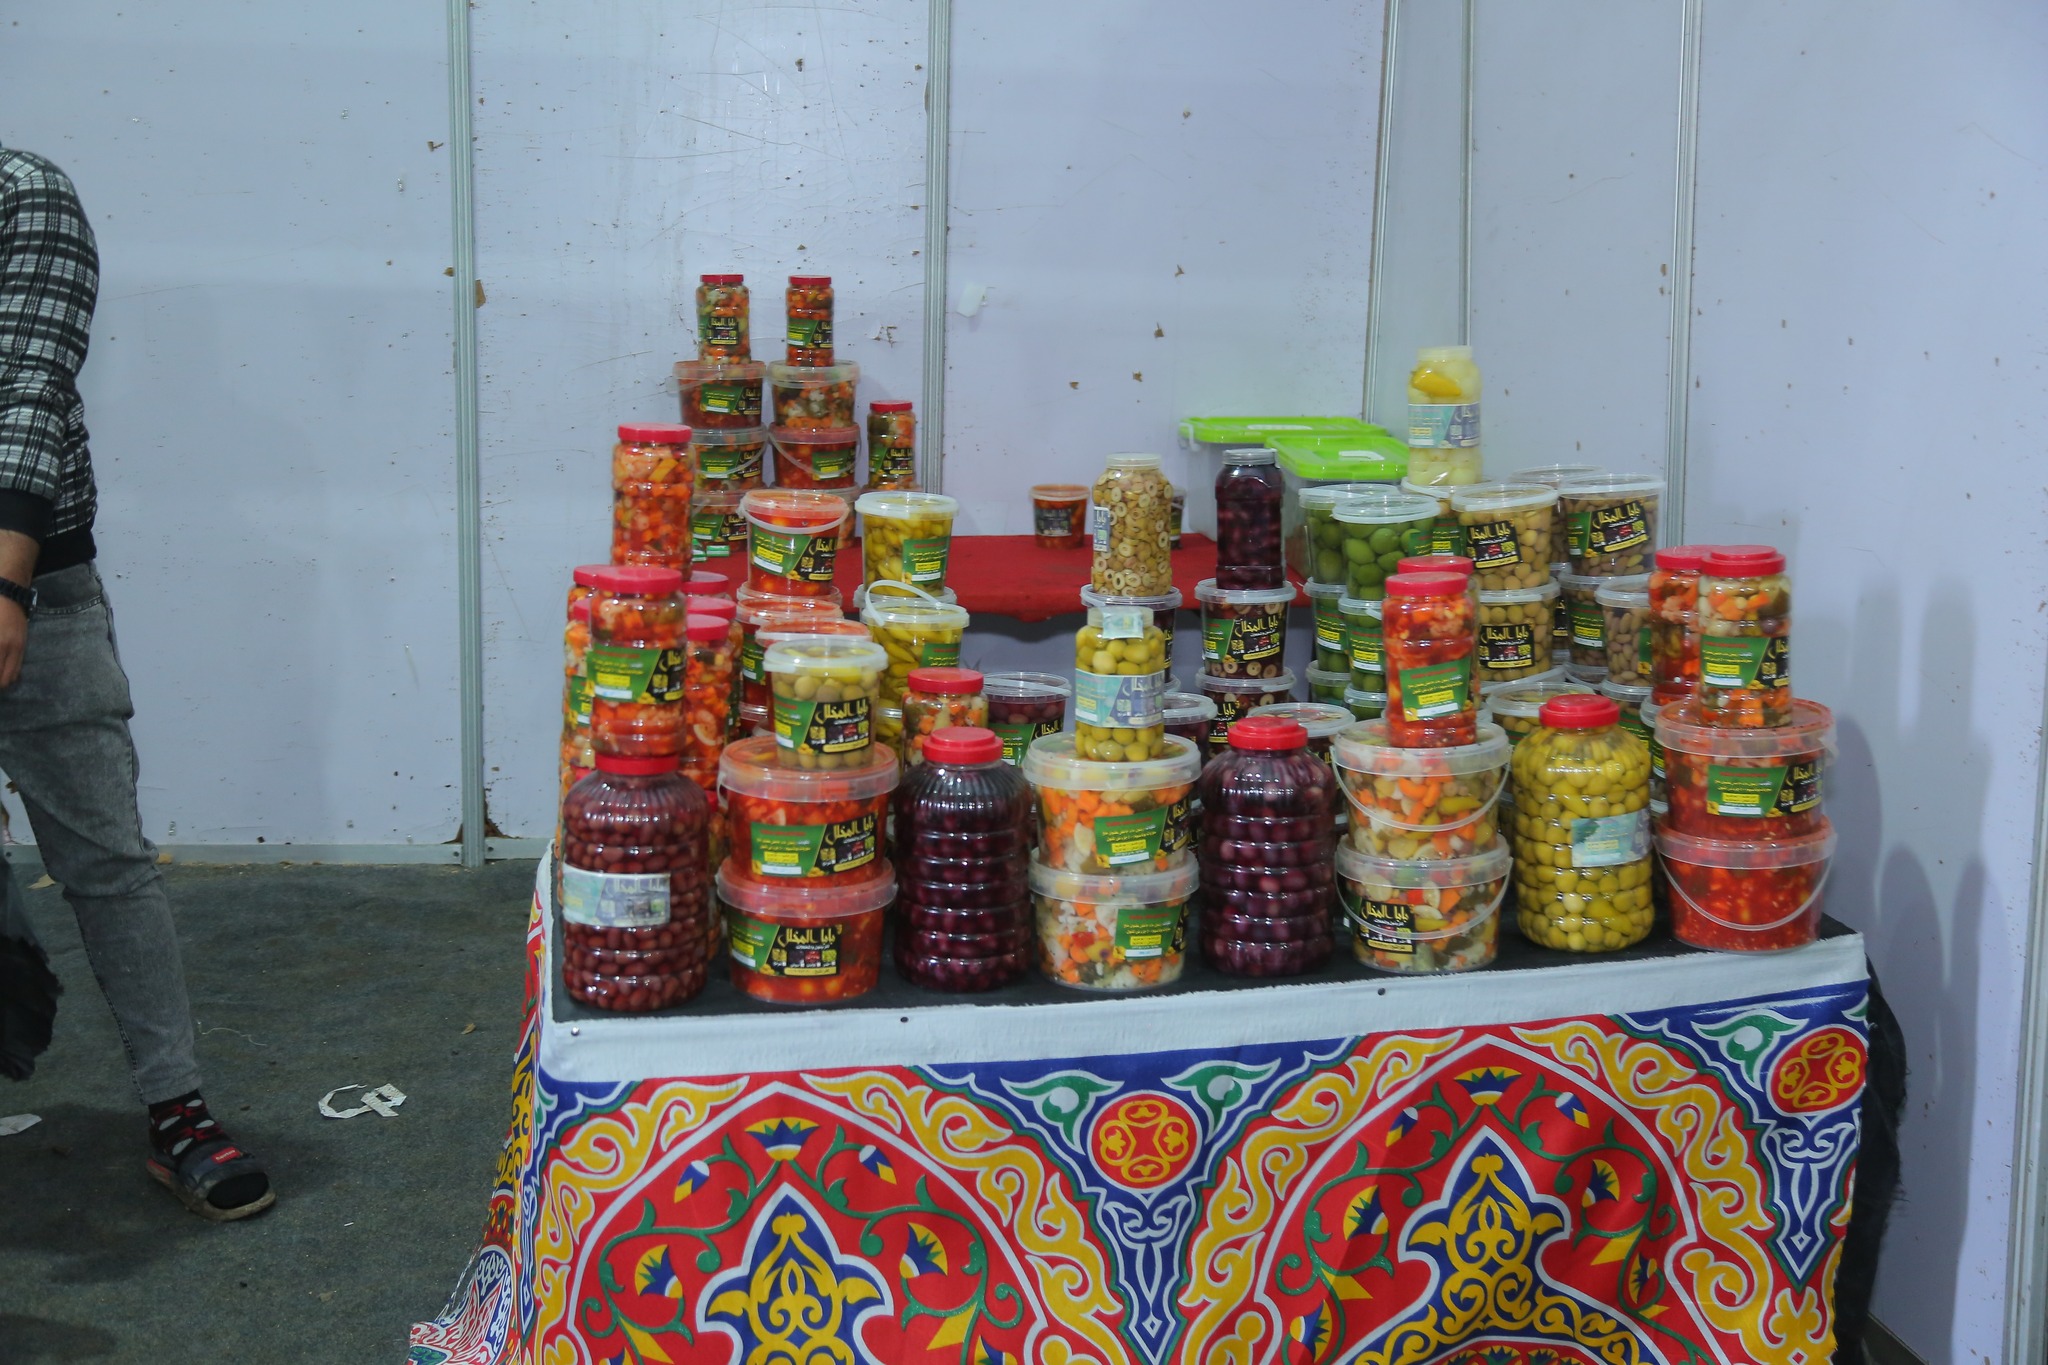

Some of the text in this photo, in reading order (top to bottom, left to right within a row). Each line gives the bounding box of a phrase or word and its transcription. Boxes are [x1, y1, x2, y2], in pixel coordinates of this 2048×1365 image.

[1592, 502, 1641, 529] بابا المخلل
[1495, 522, 1511, 539] بابا
[1234, 618, 1267, 638] المخلل
[1268, 614, 1279, 629] بابا
[1480, 625, 1530, 644] بابا المخلل
[814, 702, 856, 725] المخلل
[856, 697, 869, 716] بابا
[825, 819, 860, 845] المخلل
[863, 814, 875, 833] بابا
[1361, 901, 1394, 920] المخلل
[1393, 905, 1410, 923] بابا
[777, 928, 818, 948] المخلل
[820, 927, 836, 945] بابا
